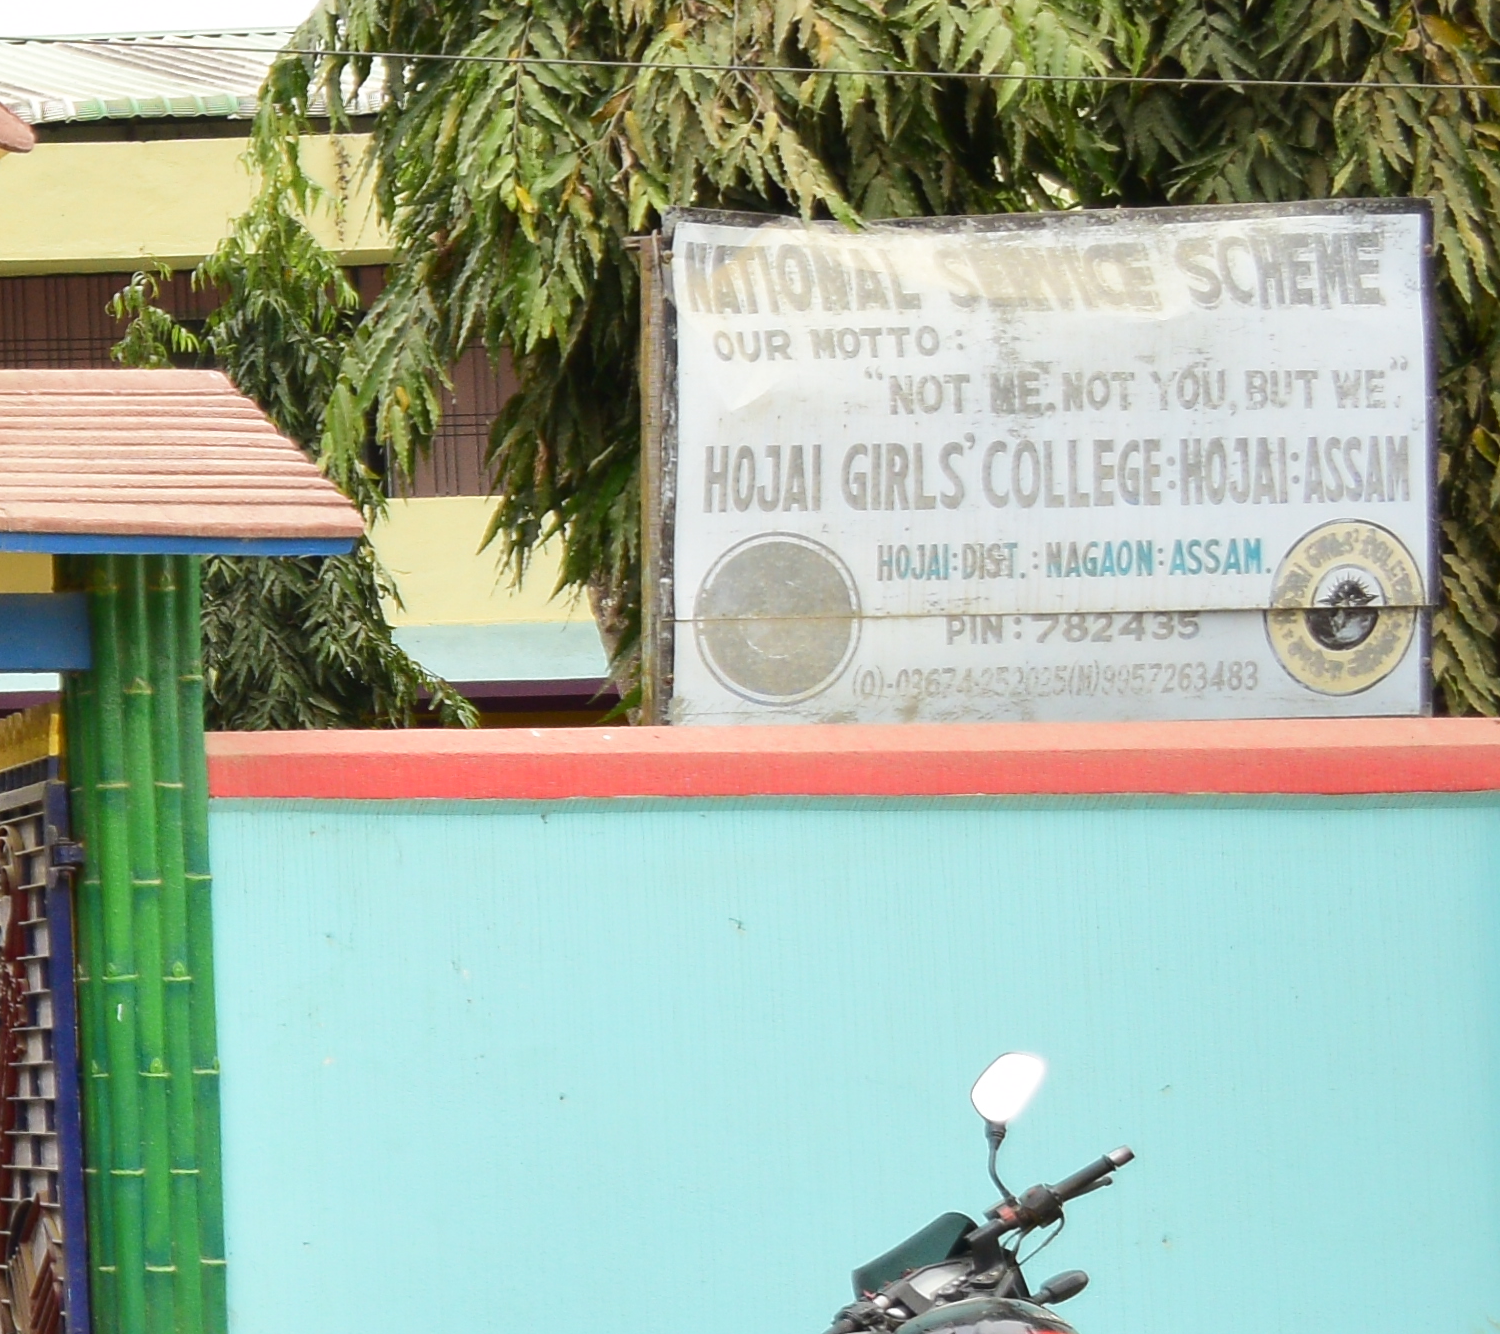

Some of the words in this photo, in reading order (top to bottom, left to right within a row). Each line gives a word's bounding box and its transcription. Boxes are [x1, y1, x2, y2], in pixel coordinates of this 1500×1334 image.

[684, 242, 922, 314] NATIONAL
[1175, 229, 1386, 311] SCHEME
[713, 329, 792, 362] OUR
[1061, 371, 1134, 413] NOT
[1245, 368, 1318, 411] BUT
[703, 443, 822, 514] HOJAI
[1303, 435, 1411, 505] ASSAM
[1029, 612, 1202, 645] 782435
